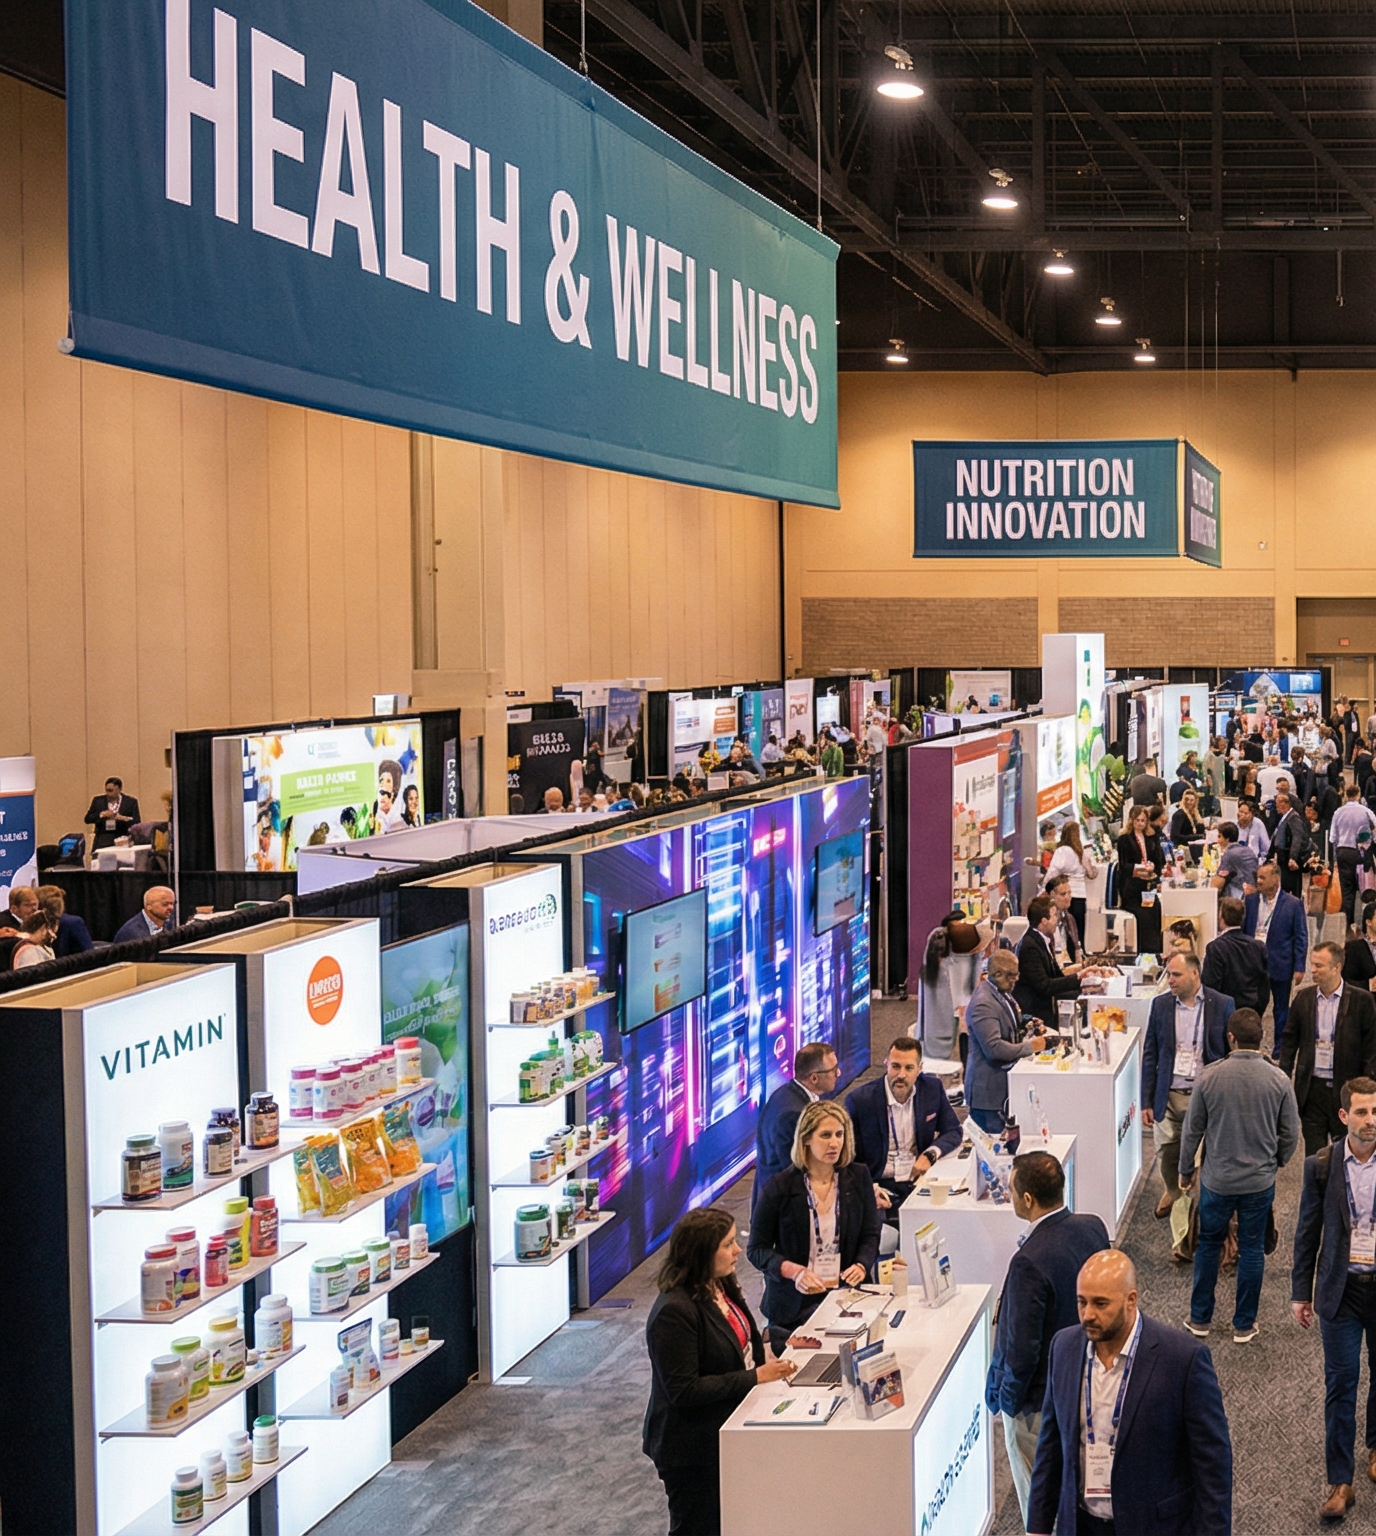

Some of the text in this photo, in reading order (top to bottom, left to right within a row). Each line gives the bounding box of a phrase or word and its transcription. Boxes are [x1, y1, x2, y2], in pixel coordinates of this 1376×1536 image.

[165, 0, 819, 425] HEALTH & WELLNESS
[956, 457, 1135, 497] NUTRITION
[946, 501, 1146, 540] INNOVATION
[101, 1015, 223, 1081] VITAMIN
